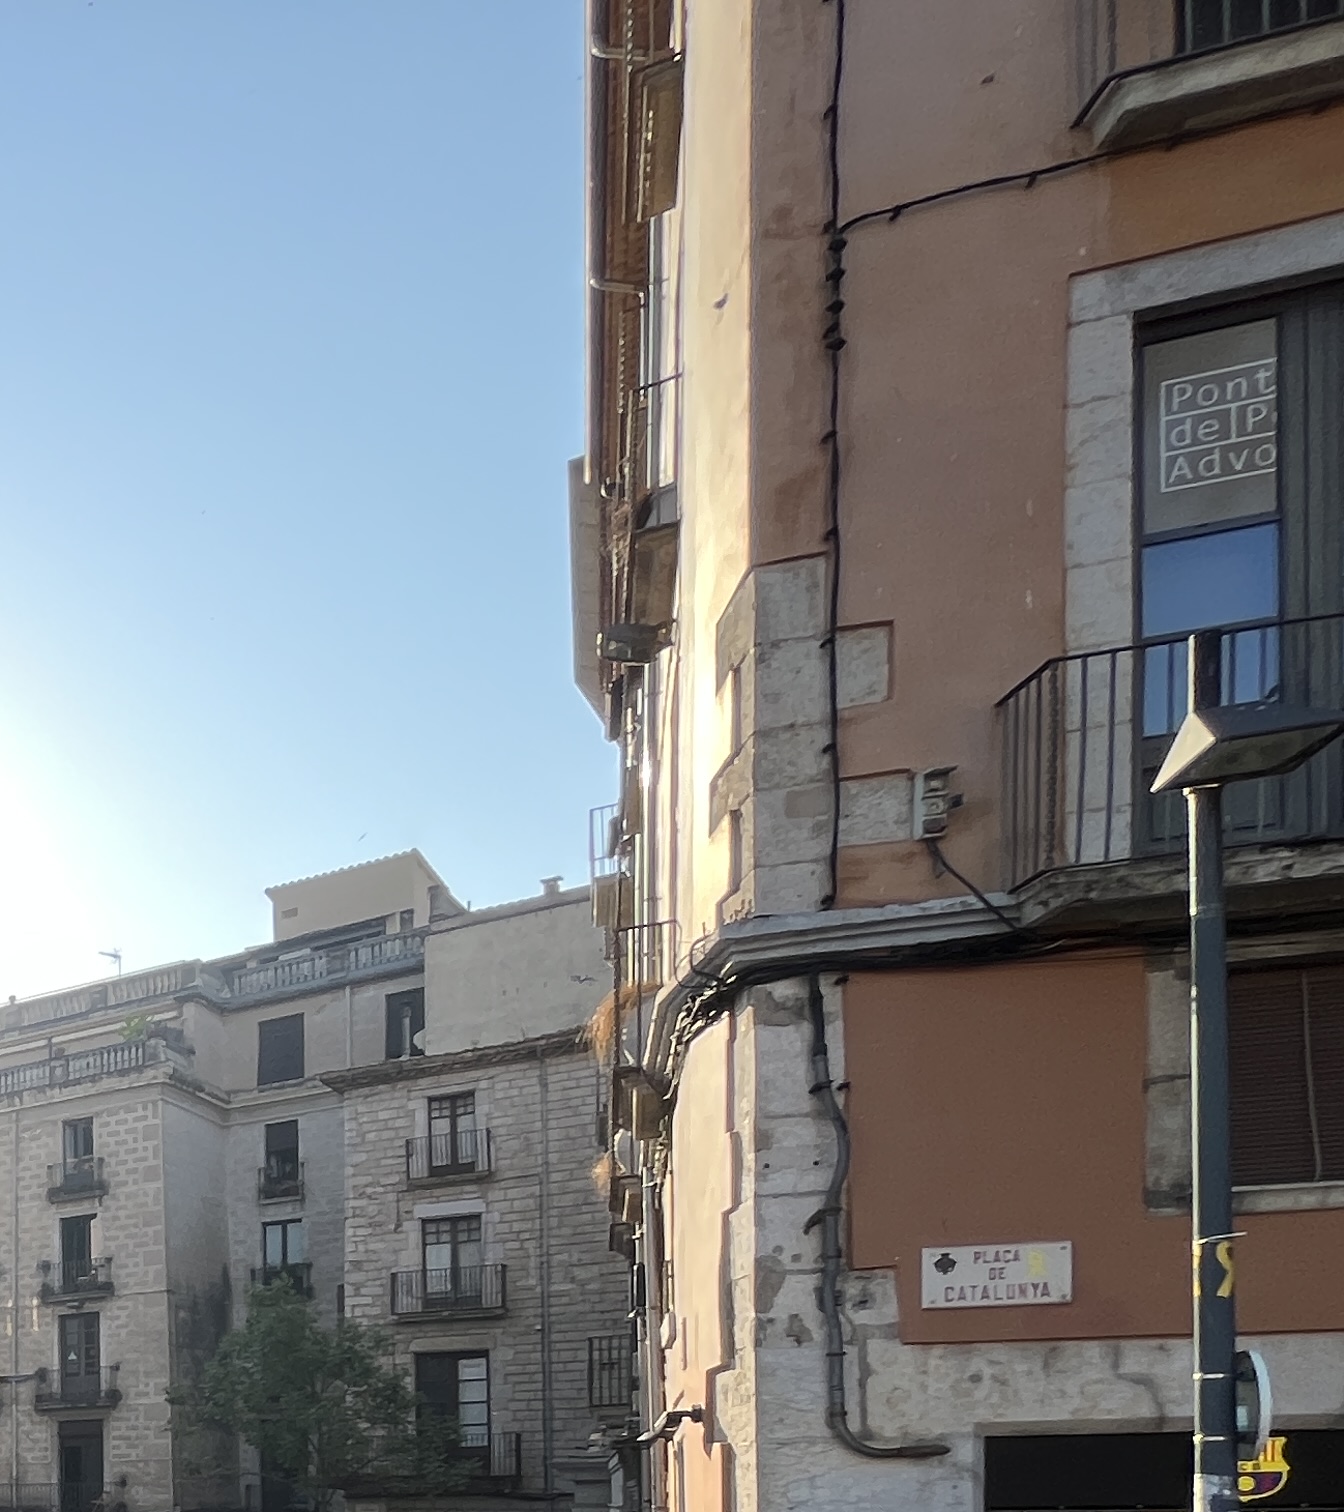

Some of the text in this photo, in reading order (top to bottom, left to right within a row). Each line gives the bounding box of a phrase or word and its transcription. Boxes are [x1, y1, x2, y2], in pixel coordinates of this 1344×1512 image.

[1169, 402, 1277, 448] de P
[1168, 441, 1277, 484] Advo
[988, 1267, 1006, 1280] DE
[944, 1281, 1051, 1303] CATALUNYA
